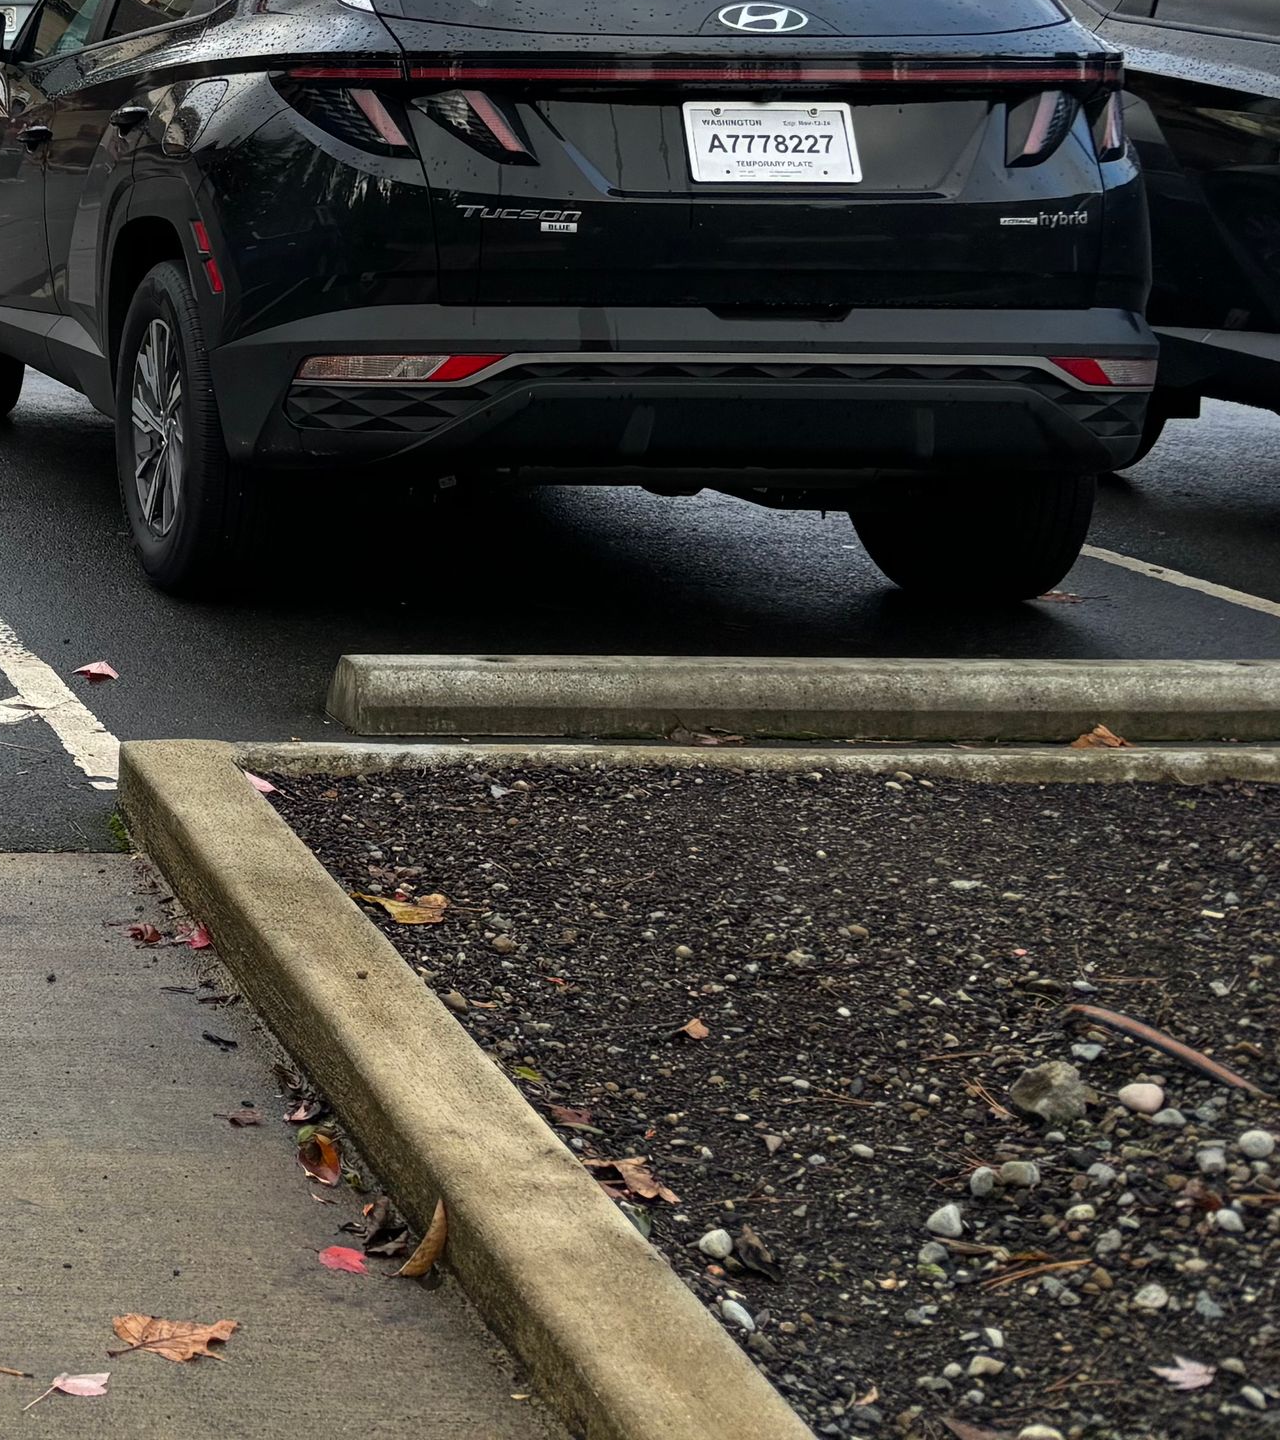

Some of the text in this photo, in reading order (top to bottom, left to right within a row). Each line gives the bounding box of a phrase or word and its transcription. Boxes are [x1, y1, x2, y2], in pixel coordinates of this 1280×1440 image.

[701, 119, 762, 127] WASHINGTON
[708, 133, 834, 154] A7778227
[736, 160, 786, 168] TEMPORARY
[1039, 210, 1088, 229] hybrid
[548, 223, 571, 231] BLUE
